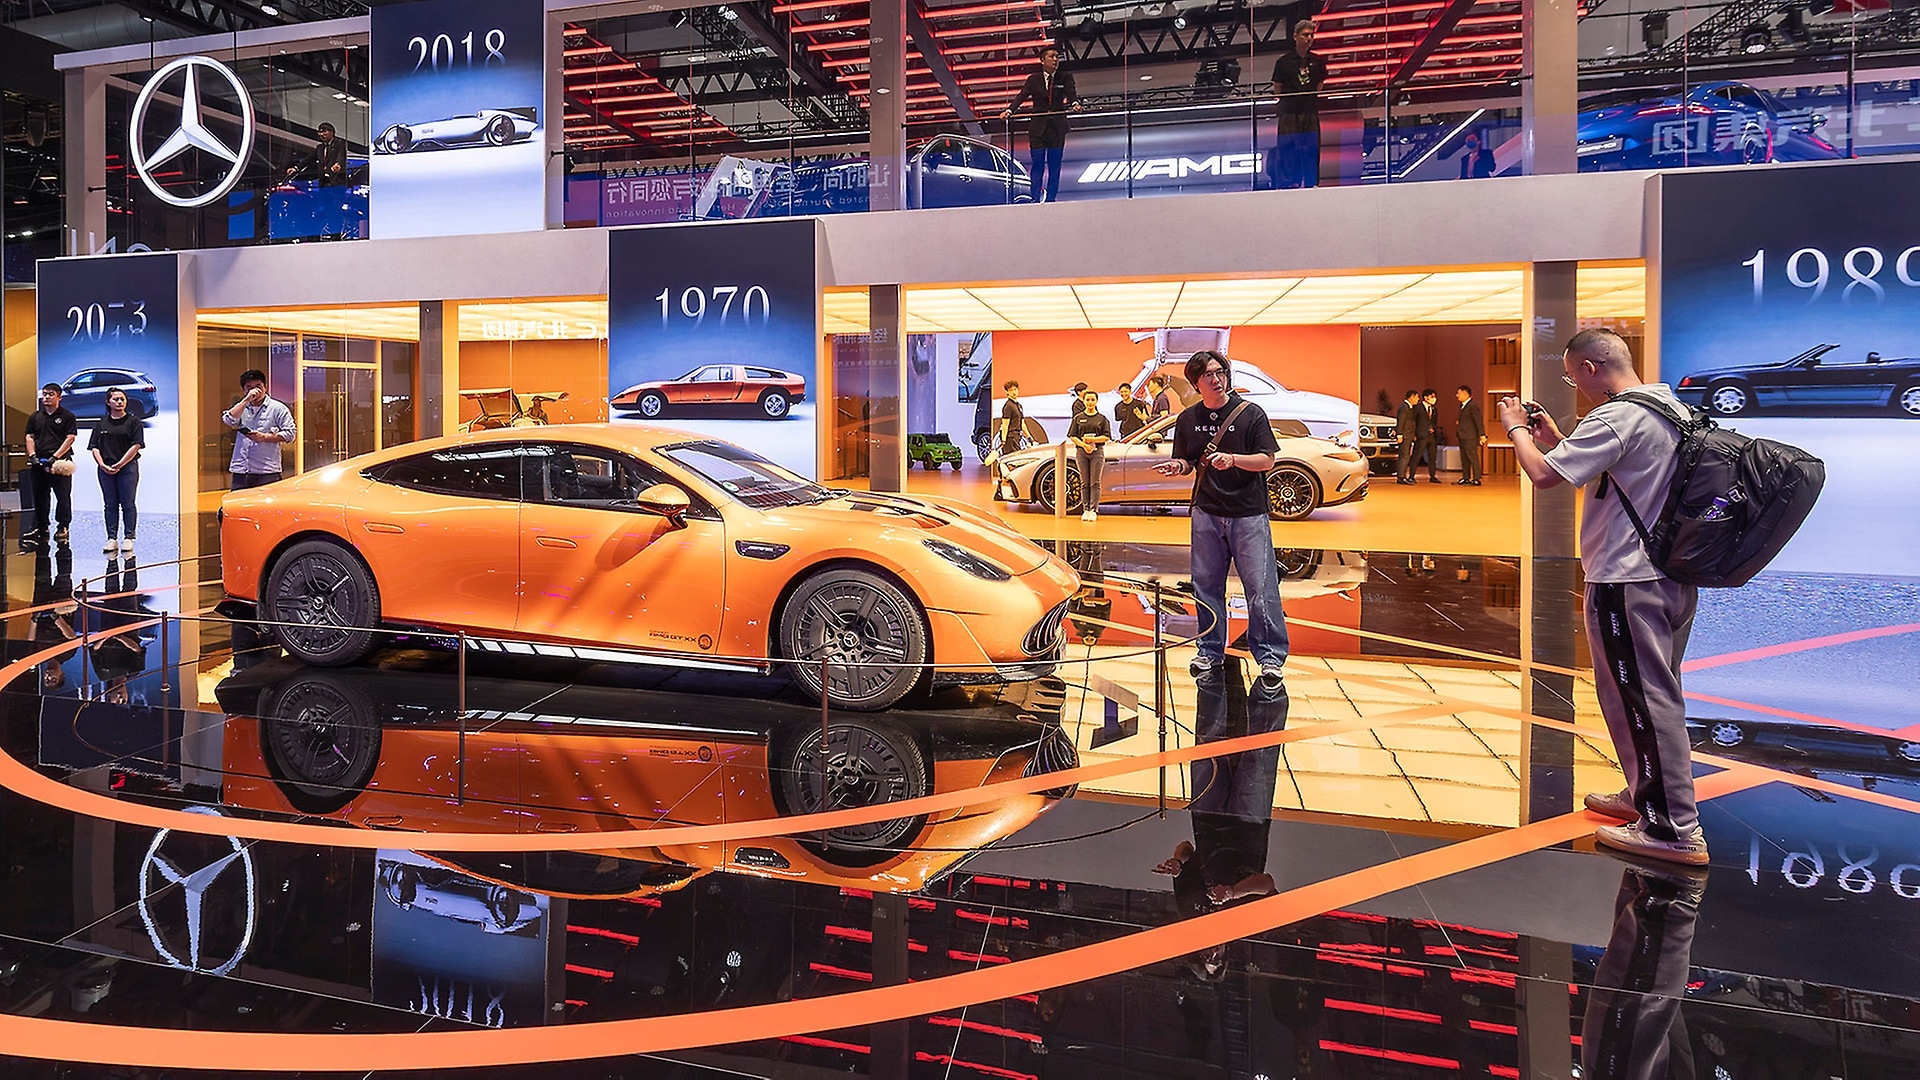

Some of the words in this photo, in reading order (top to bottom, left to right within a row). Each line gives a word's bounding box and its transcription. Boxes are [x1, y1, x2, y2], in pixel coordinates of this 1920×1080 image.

[407, 28, 506, 75] 2018
[1136, 153, 1262, 179] AMG
[655, 285, 771, 332] 1970
